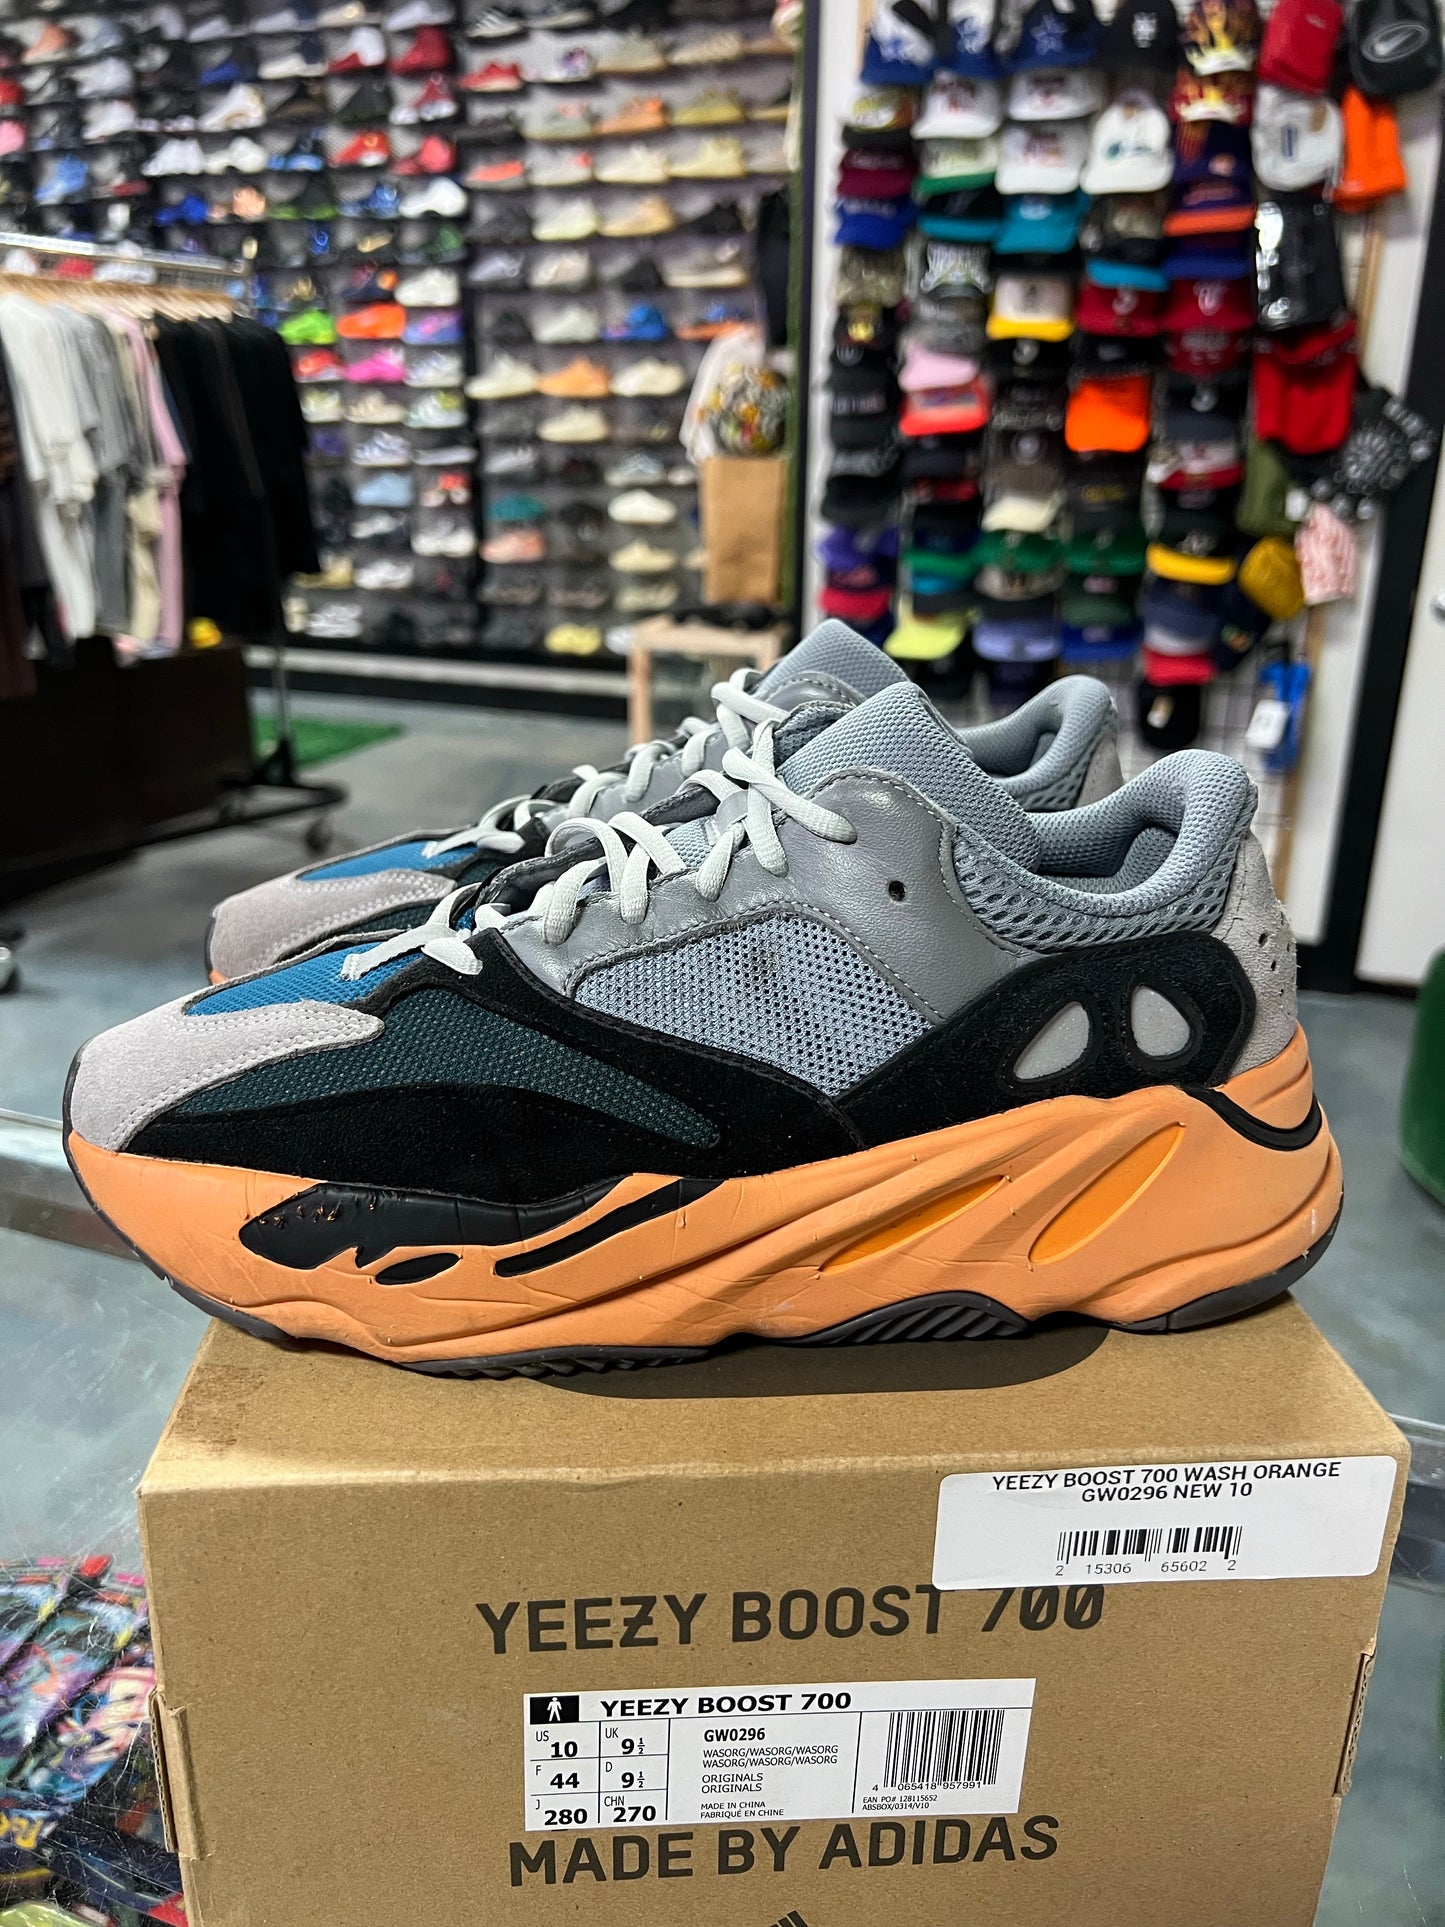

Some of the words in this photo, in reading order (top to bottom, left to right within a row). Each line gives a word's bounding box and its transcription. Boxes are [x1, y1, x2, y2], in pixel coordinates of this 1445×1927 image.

[992, 1473, 1058, 1491] YEEZY
[1063, 1469, 1136, 1487] BOOST
[1141, 1468, 1178, 1484] 700
[1184, 1465, 1247, 1482] WASH
[1253, 1462, 1342, 1479] ORANGE
[1081, 1485, 1168, 1503] GW0296
[1173, 1483, 1224, 1499] NEW
[1230, 1482, 1253, 1497] 10
[1055, 1565, 1064, 1576] 2
[1087, 1563, 1132, 1575] 15306
[1161, 1561, 1208, 1573] 65602
[1227, 1560, 1237, 1571] 2
[475, 1592, 707, 1654] YEEZY
[731, 1585, 957, 1643] BOOST
[981, 1583, 1106, 1633] 700
[600, 1697, 690, 1717] YEEZY
[698, 1694, 793, 1714] BOOST
[800, 1692, 852, 1710] 700
[605, 1727, 619, 1739] UK
[704, 1727, 766, 1742] GW0296
[535, 1730, 550, 1742] US
[551, 1741, 578, 1758] 10
[703, 1745, 839, 1758] WASORG/WASORG/WASORG
[605, 1761, 613, 1773] D
[702, 1755, 838, 1768] WASORG/WASORG/WASORG
[535, 1764, 542, 1776] F
[550, 1772, 580, 1789] 44
[701, 1773, 764, 1783] ORIGINALS
[701, 1783, 763, 1794] ORIGINALS
[872, 1784, 879, 1792] 4
[897, 1782, 937, 1791] 065418
[943, 1781, 981, 1790] 957991
[604, 1796, 625, 1807] CHN
[700, 1802, 725, 1810] MADE
[739, 1801, 766, 1809] CHINA
[863, 1796, 878, 1804] EAN
[535, 1799, 541, 1810] J
[544, 1808, 588, 1826] 280
[613, 1805, 657, 1823] 270
[744, 1809, 756, 1817] EN
[758, 1809, 785, 1817] CHINE
[509, 1831, 694, 1887] MADE
[717, 1825, 801, 1874] BY
[818, 1813, 1060, 1869] ADIDAS
